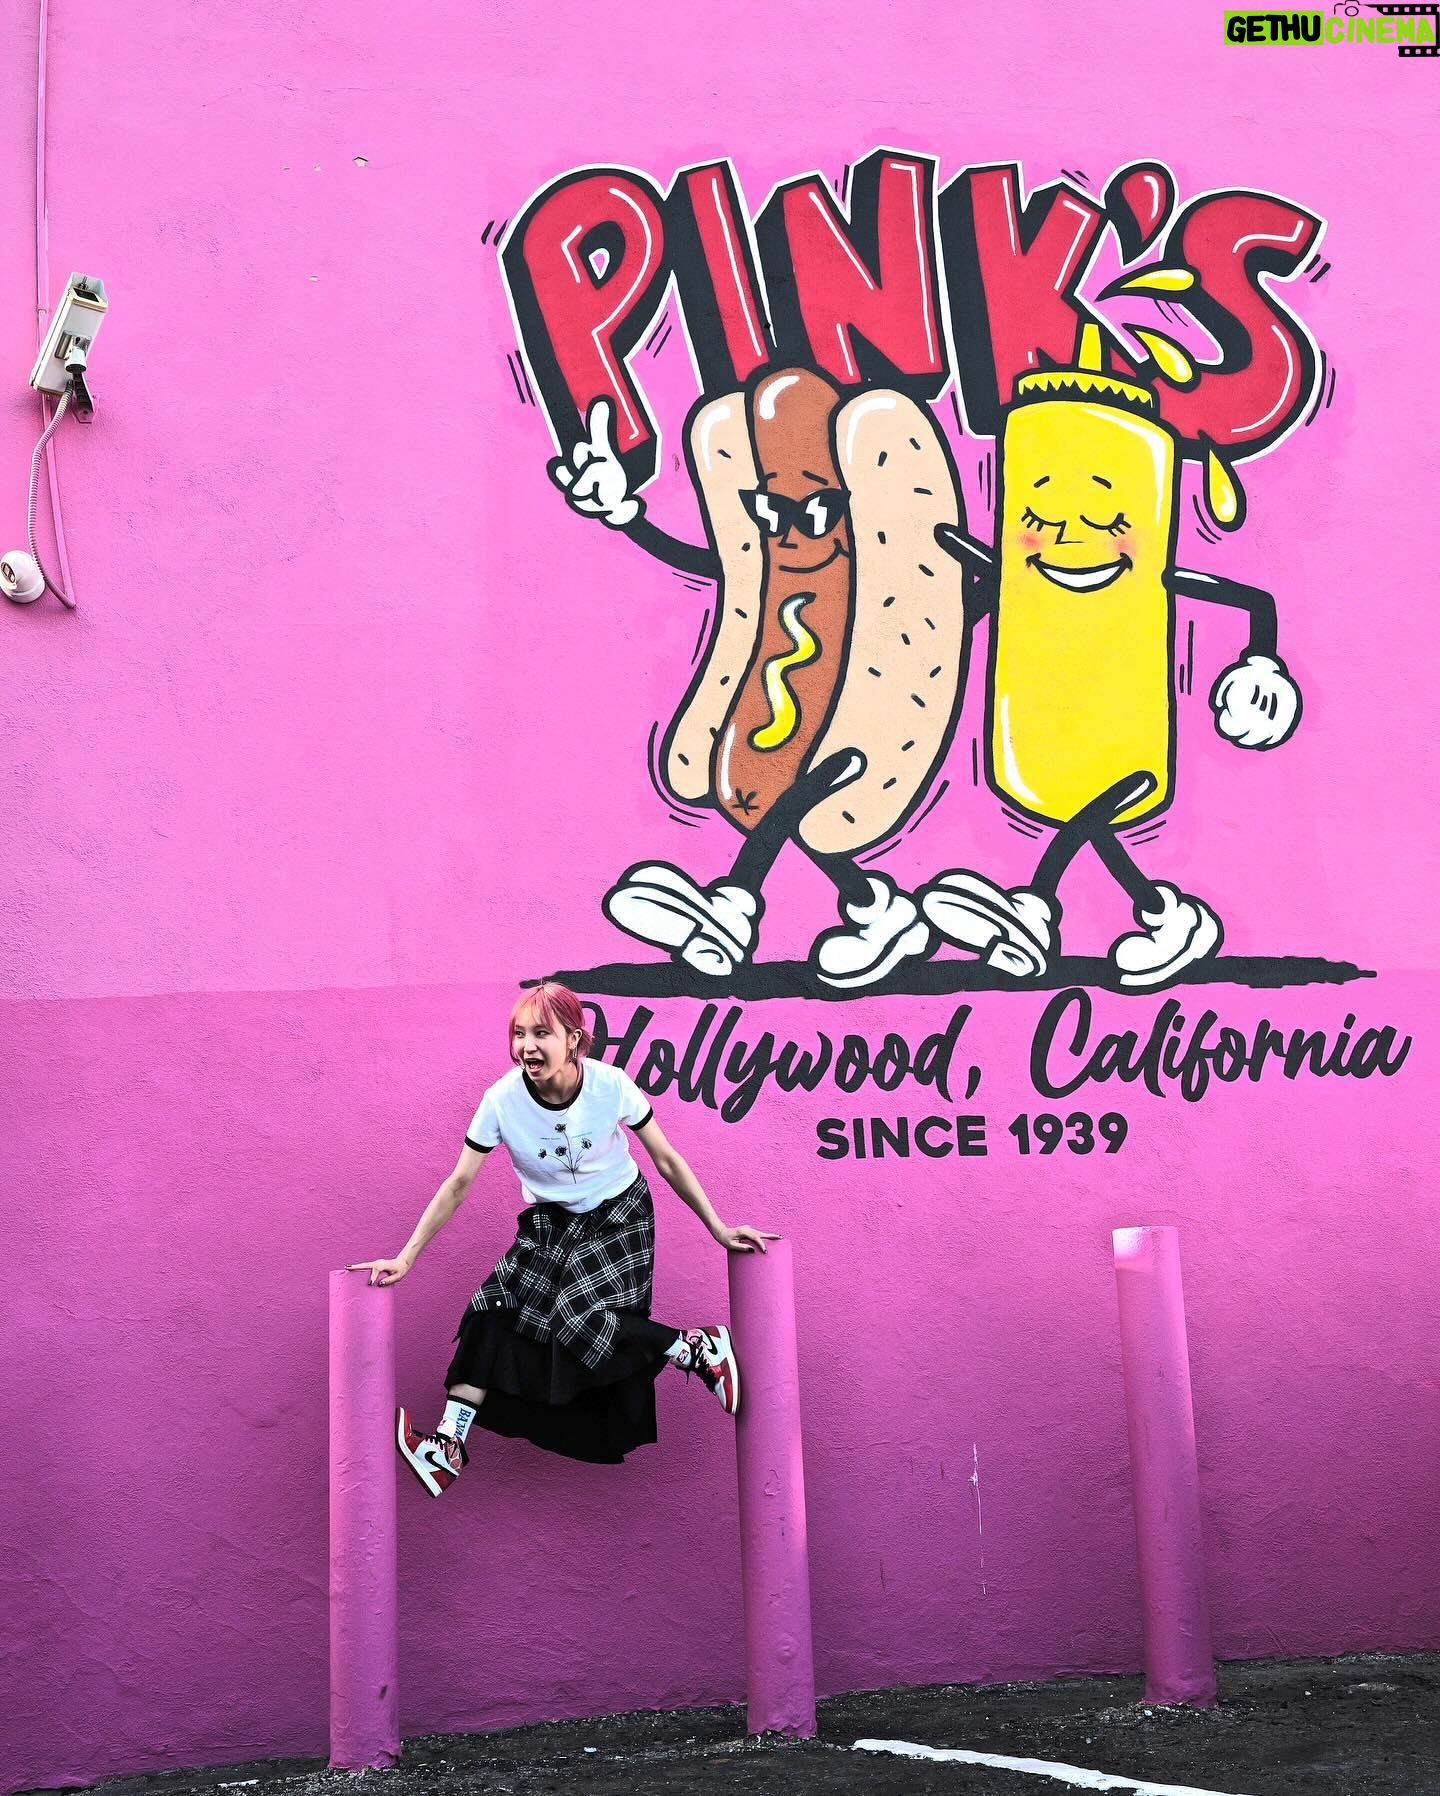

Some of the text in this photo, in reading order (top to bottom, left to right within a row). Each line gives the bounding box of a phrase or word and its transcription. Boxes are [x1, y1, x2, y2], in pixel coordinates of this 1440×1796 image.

[500, 147, 1326, 494] PINK'S
[582, 988, 1412, 1123] Hollywood, California
[817, 1112, 1128, 1159] SINCE 1939
